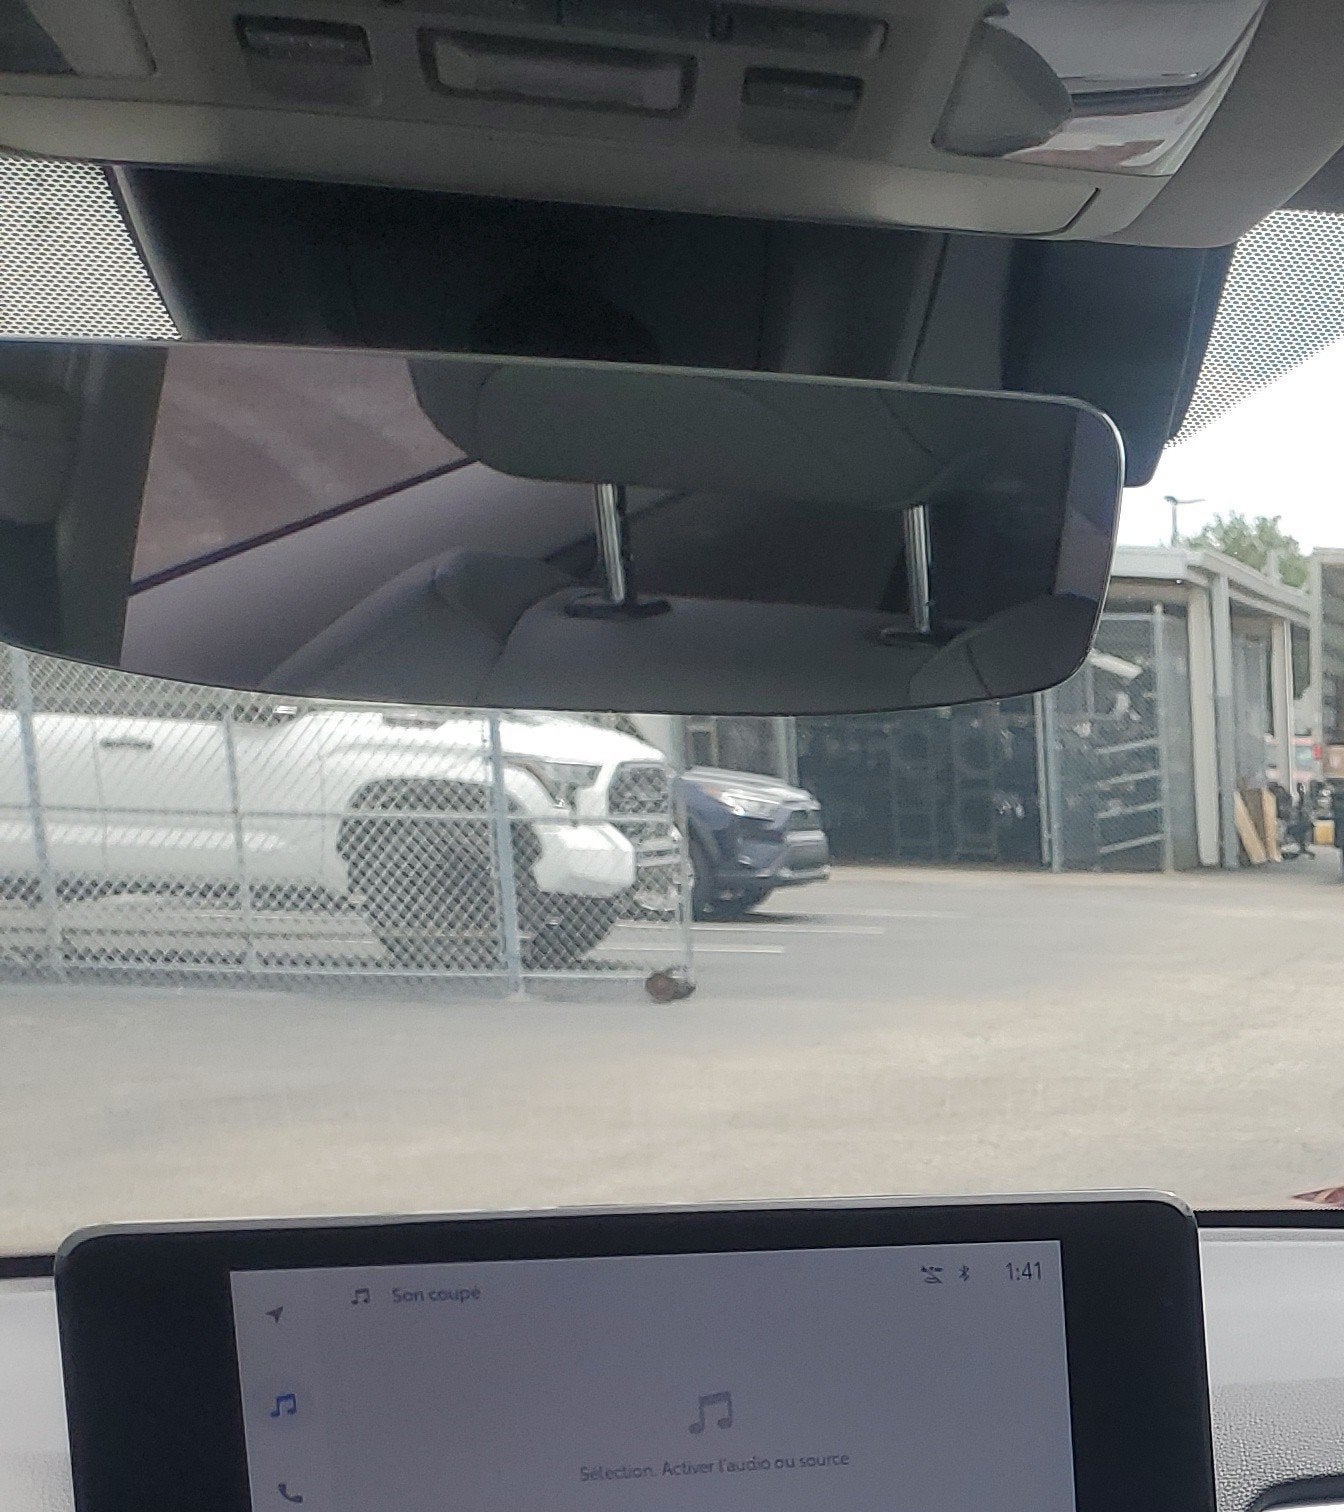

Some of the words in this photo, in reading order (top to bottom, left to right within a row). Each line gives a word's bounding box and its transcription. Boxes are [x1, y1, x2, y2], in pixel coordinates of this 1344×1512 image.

[1005, 1261, 1042, 1282] 1:41
[774, 1458, 795, 1470] ou
[799, 1454, 850, 1468] source
